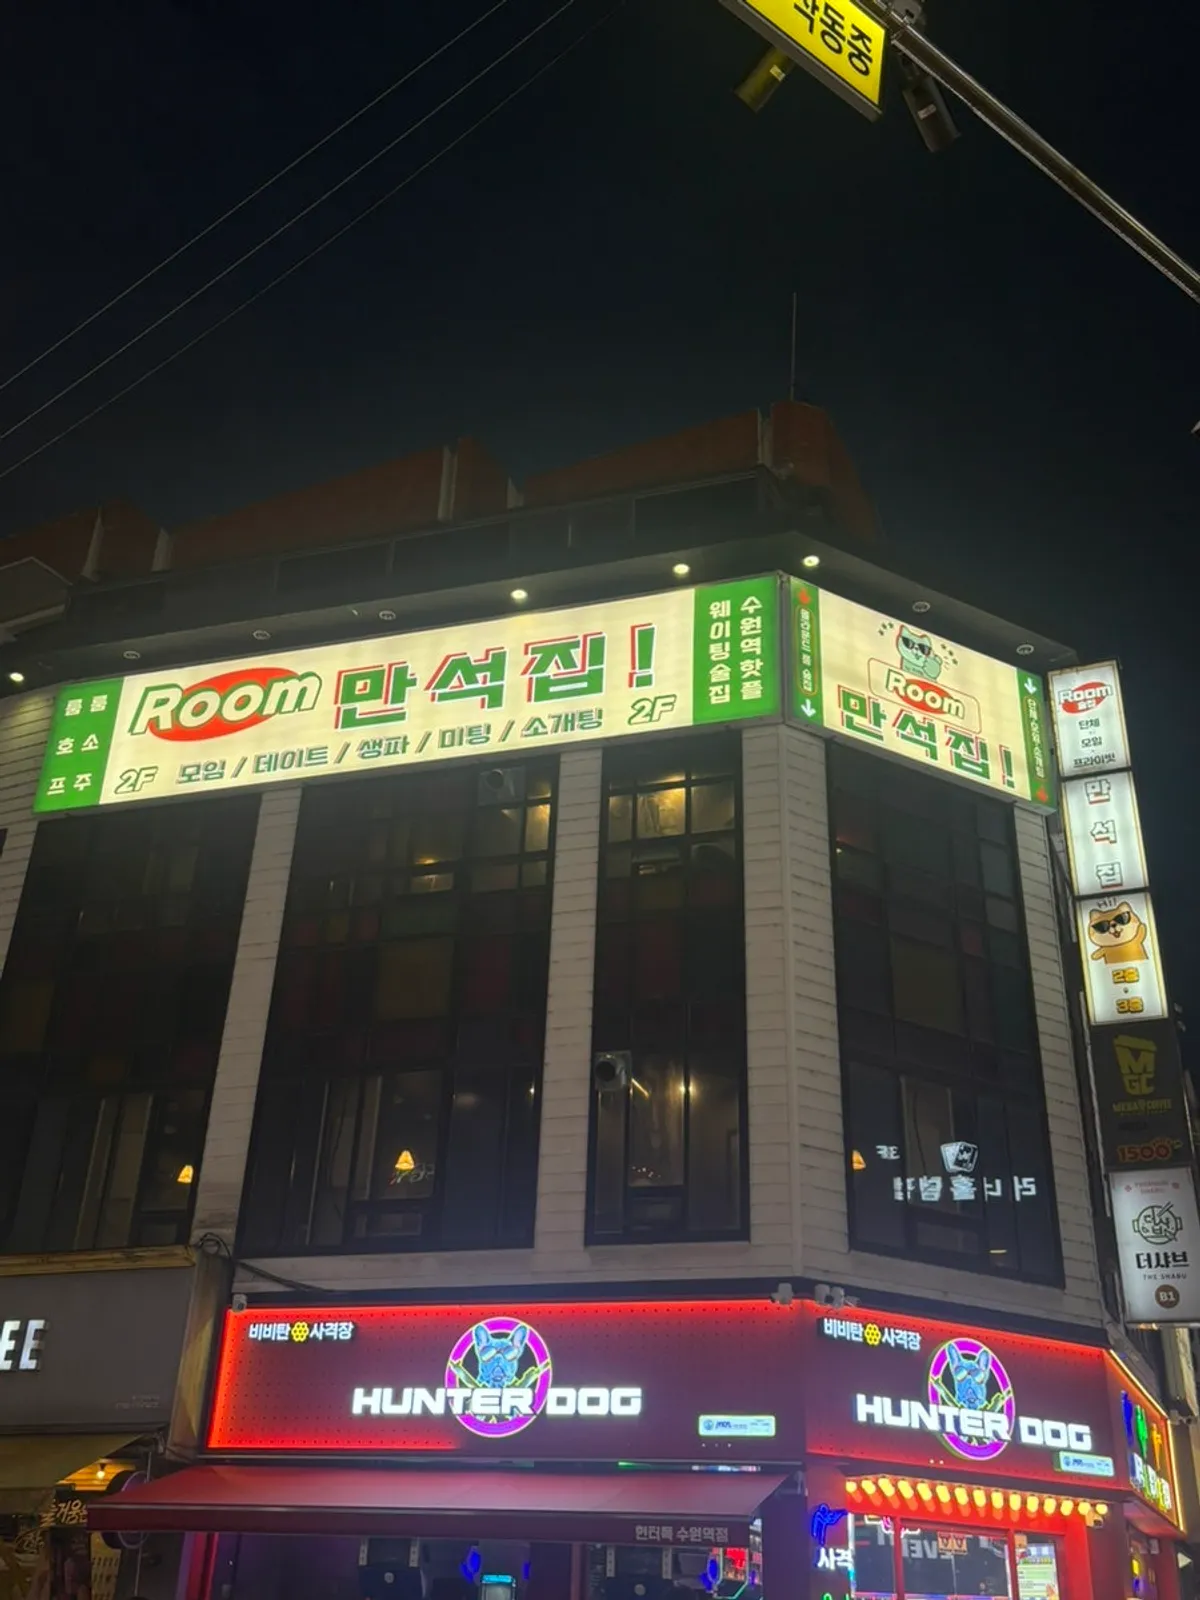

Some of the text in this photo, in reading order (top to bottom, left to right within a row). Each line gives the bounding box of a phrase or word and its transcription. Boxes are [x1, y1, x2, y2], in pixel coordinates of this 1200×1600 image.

[709, 600, 731, 704] 웨이팅술집
[740, 596, 763, 700] 수원역핫플
[128, 671, 322, 736] Room
[627, 694, 678, 725] 2F
[885, 669, 966, 720] Room
[176, 760, 227, 784] 모임
[252, 746, 328, 774] 데이트
[357, 735, 410, 760] 생파
[438, 723, 491, 749] 미팅
[520, 708, 603, 738] 소개팅
[115, 766, 158, 794] 2F
[1135, 1251, 1190, 1269] 더샤브
[1160, 1291, 1176, 1300] B1
[249, 1321, 355, 1340] 비비탄 사격장
[823, 1318, 921, 1350] 비비탄 사격장
[352, 1387, 643, 1416] HUNTER DOG
[856, 1393, 1093, 1451] HUNTER DOG
[676, 1527, 729, 1543] 수원역점
